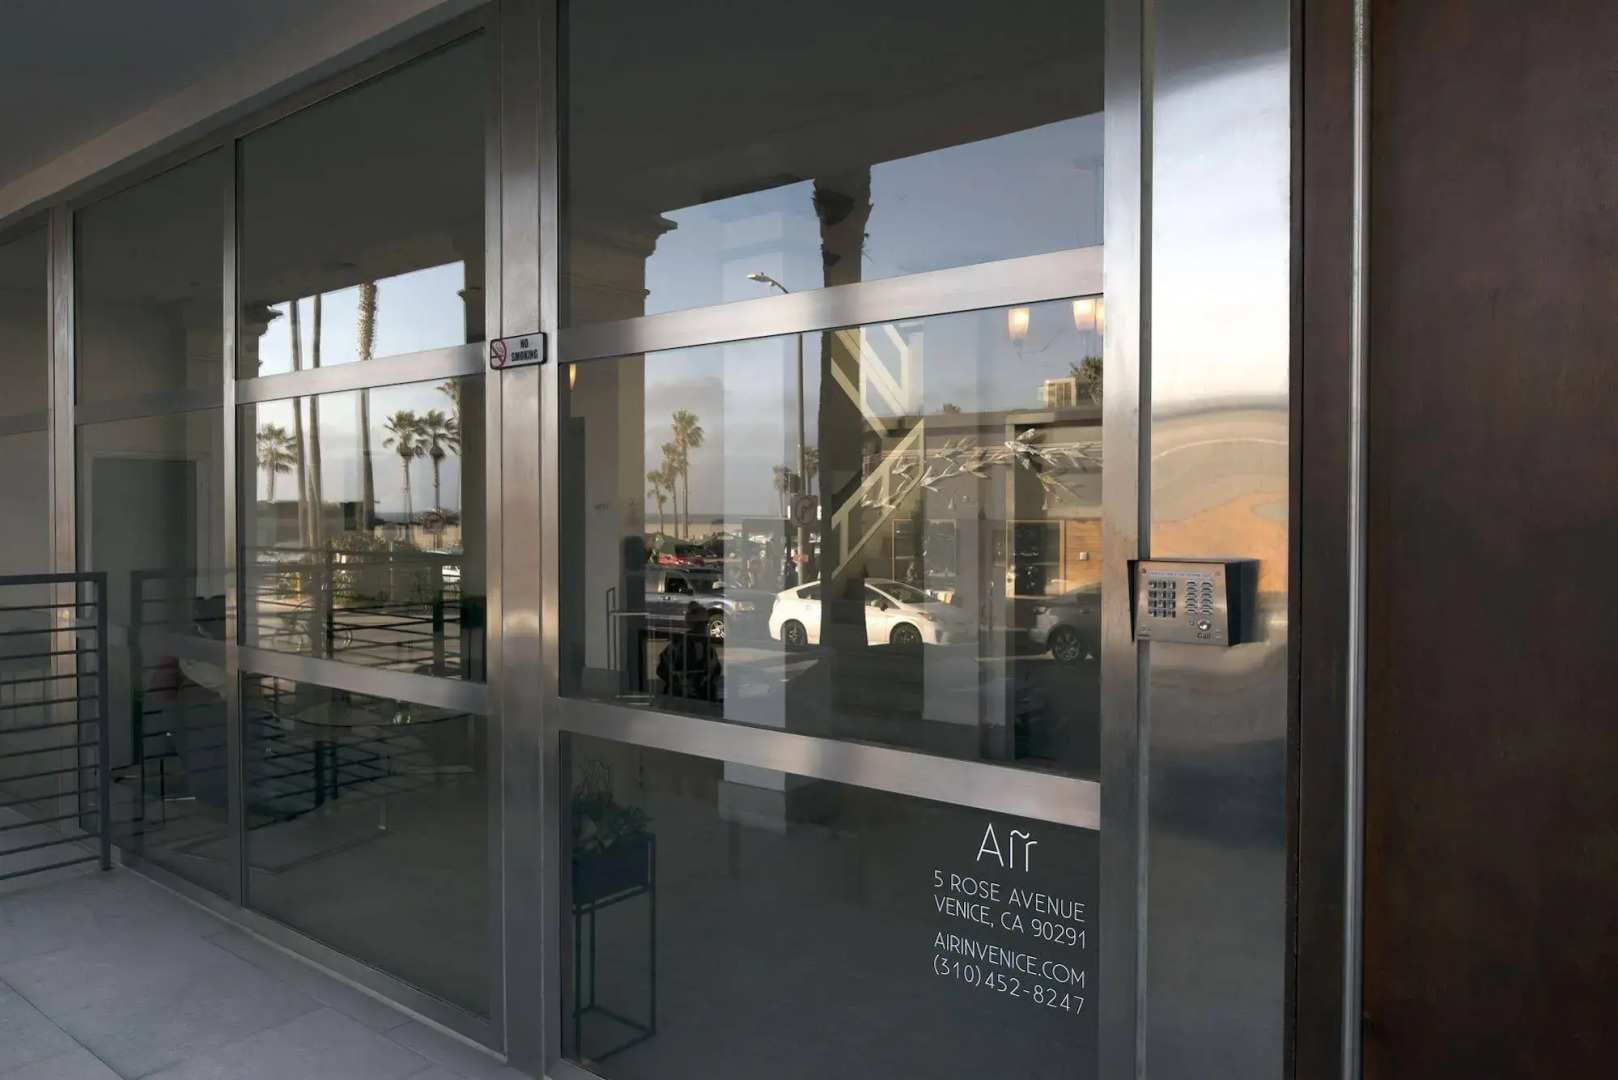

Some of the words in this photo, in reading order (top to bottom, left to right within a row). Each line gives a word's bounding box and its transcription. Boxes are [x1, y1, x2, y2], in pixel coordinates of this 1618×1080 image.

[511, 349, 538, 362] SMOKING
[520, 338, 529, 349] NO
[1197, 632, 1212, 640] Call
[933, 869, 944, 888] 5
[950, 873, 1000, 902] ROSE
[1008, 888, 1085, 923] AVENUE
[934, 894, 994, 928] VENICE,
[1000, 911, 1024, 933] CA
[1031, 918, 1086, 949] 90291
[933, 954, 1085, 1015] (310)452-8247
[934, 931, 1085, 988] AIRINVENICE.COM
